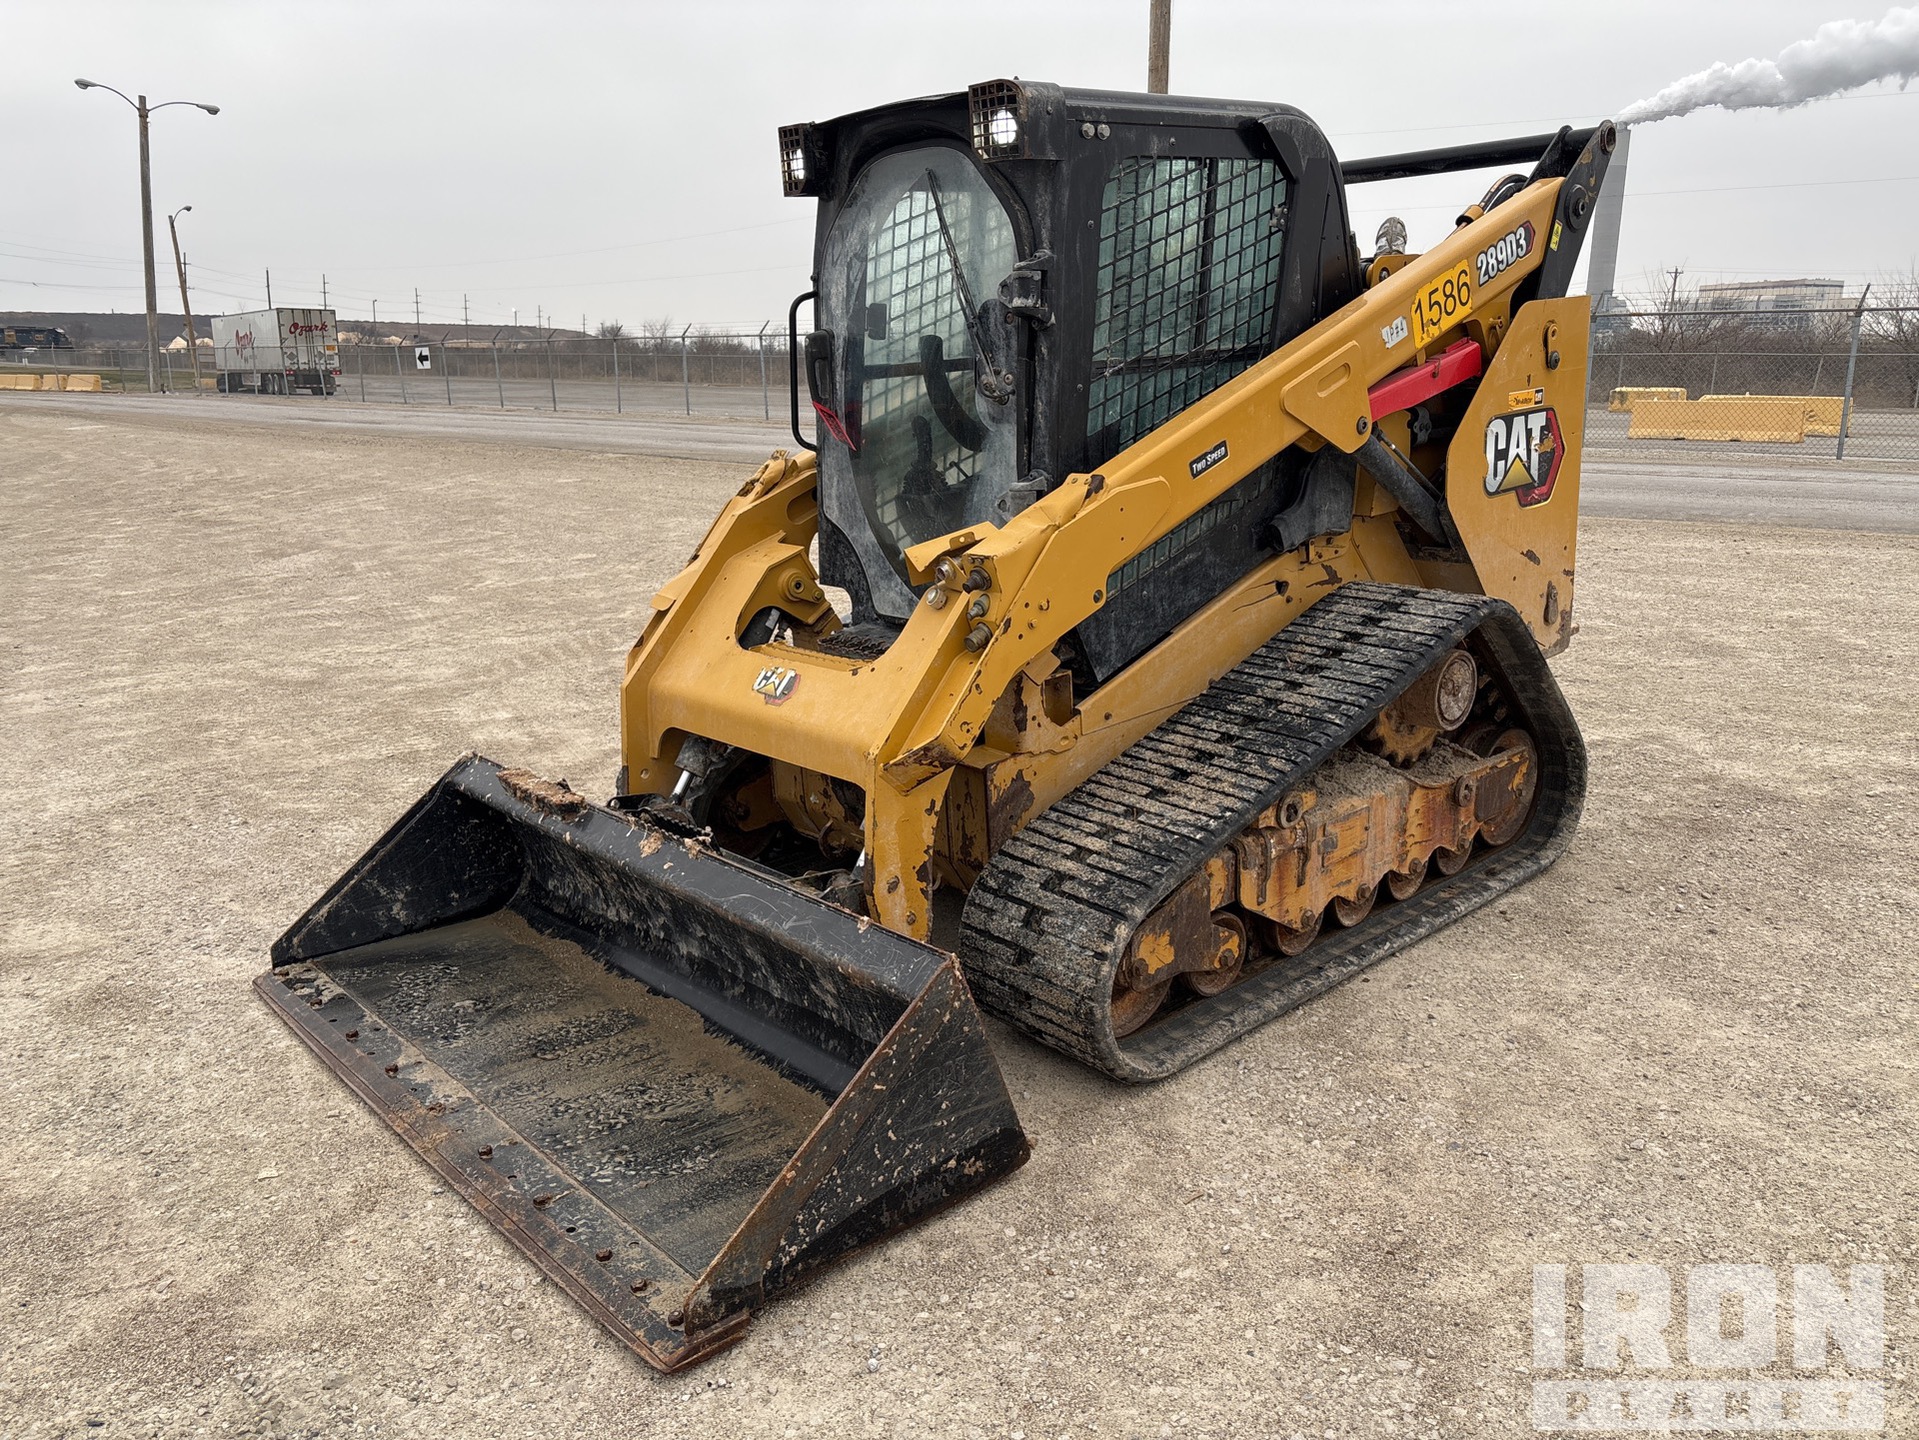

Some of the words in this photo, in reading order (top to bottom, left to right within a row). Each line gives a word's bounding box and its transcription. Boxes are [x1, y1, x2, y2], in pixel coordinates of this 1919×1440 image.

[1476, 225, 1528, 287] 289D3
[289, 321, 328, 336] Ozark
[1414, 268, 1471, 334] 1586
[1485, 411, 1547, 493] CAT
